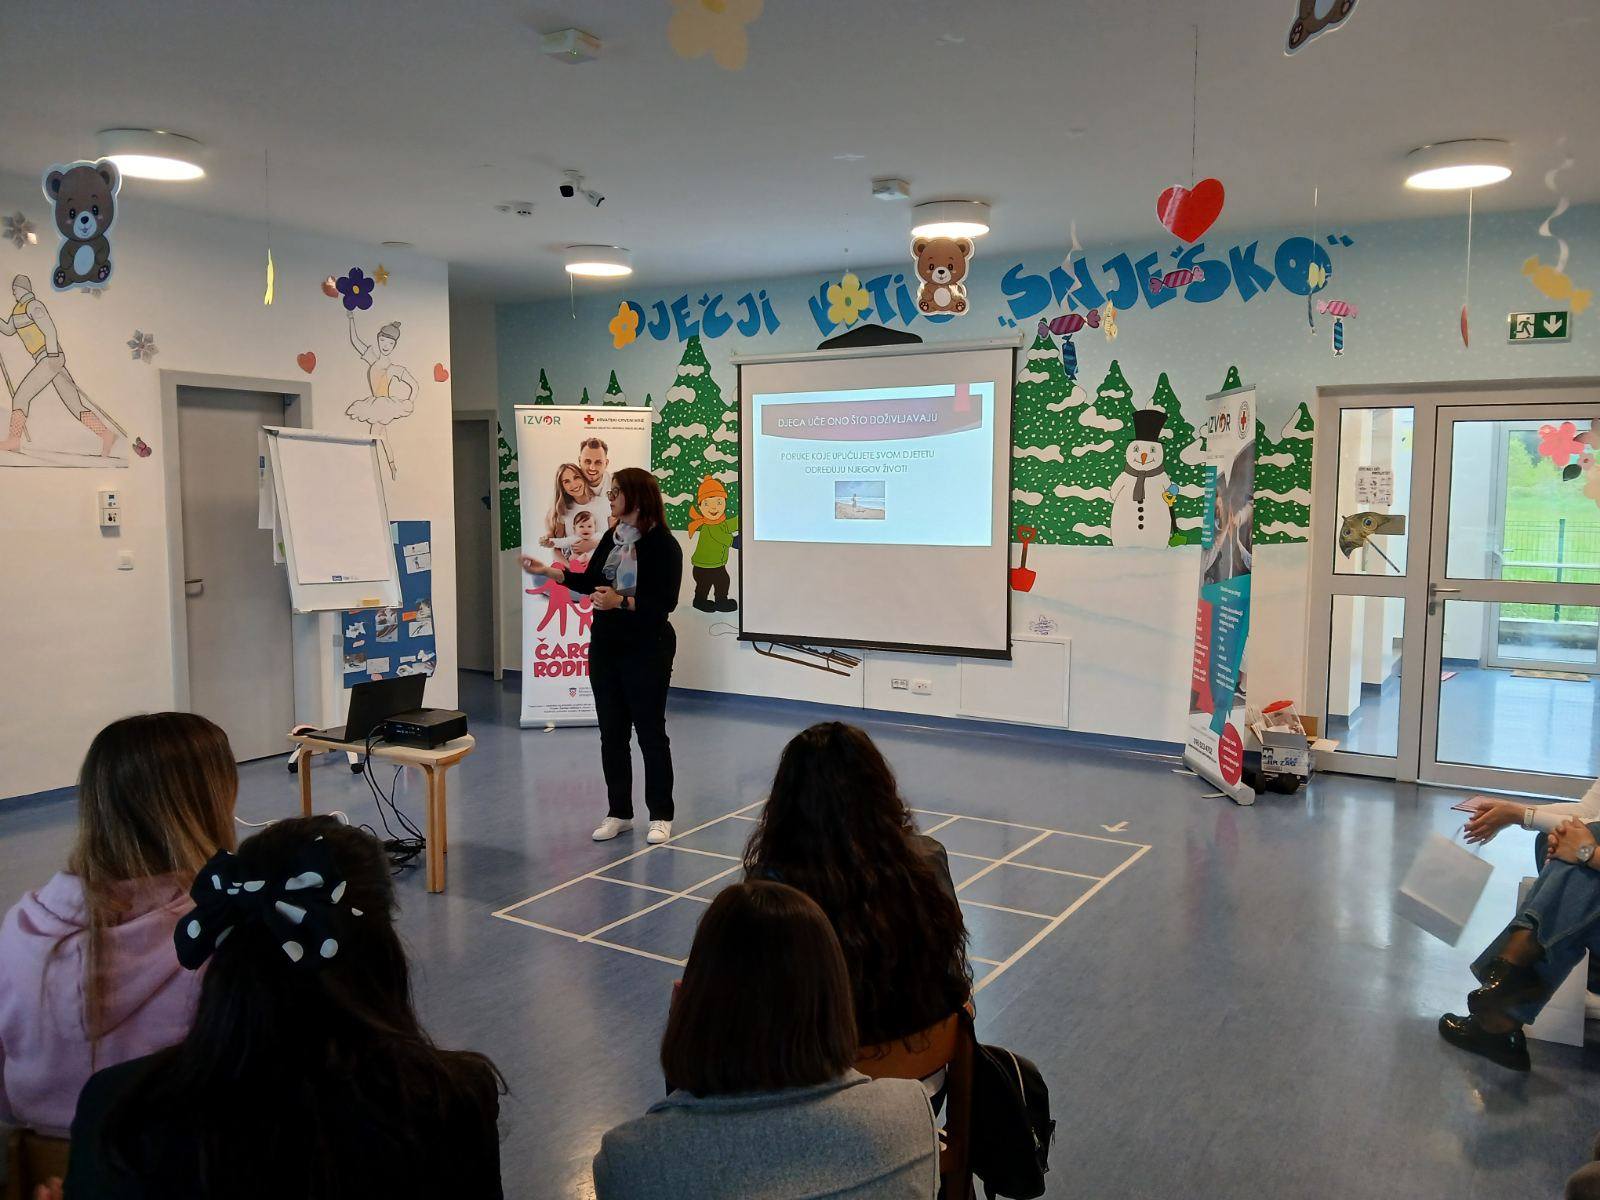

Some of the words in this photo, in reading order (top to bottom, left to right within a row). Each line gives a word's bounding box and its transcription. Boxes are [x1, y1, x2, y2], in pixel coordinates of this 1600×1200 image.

[523, 415, 561, 425] IZVOR
[778, 416, 806, 428] DJECA
[808, 415, 826, 427] UČE
[827, 416, 849, 426] ONO
[851, 414, 868, 425] ŠTO
[869, 412, 938, 424] DOŽIVLJAVAJU
[781, 452, 810, 461] PORUKE
[811, 452, 831, 460] KOJE
[876, 451, 901, 459] SVOM
[902, 450, 935, 459] DJETETU
[847, 465, 882, 473] NJEGOV
